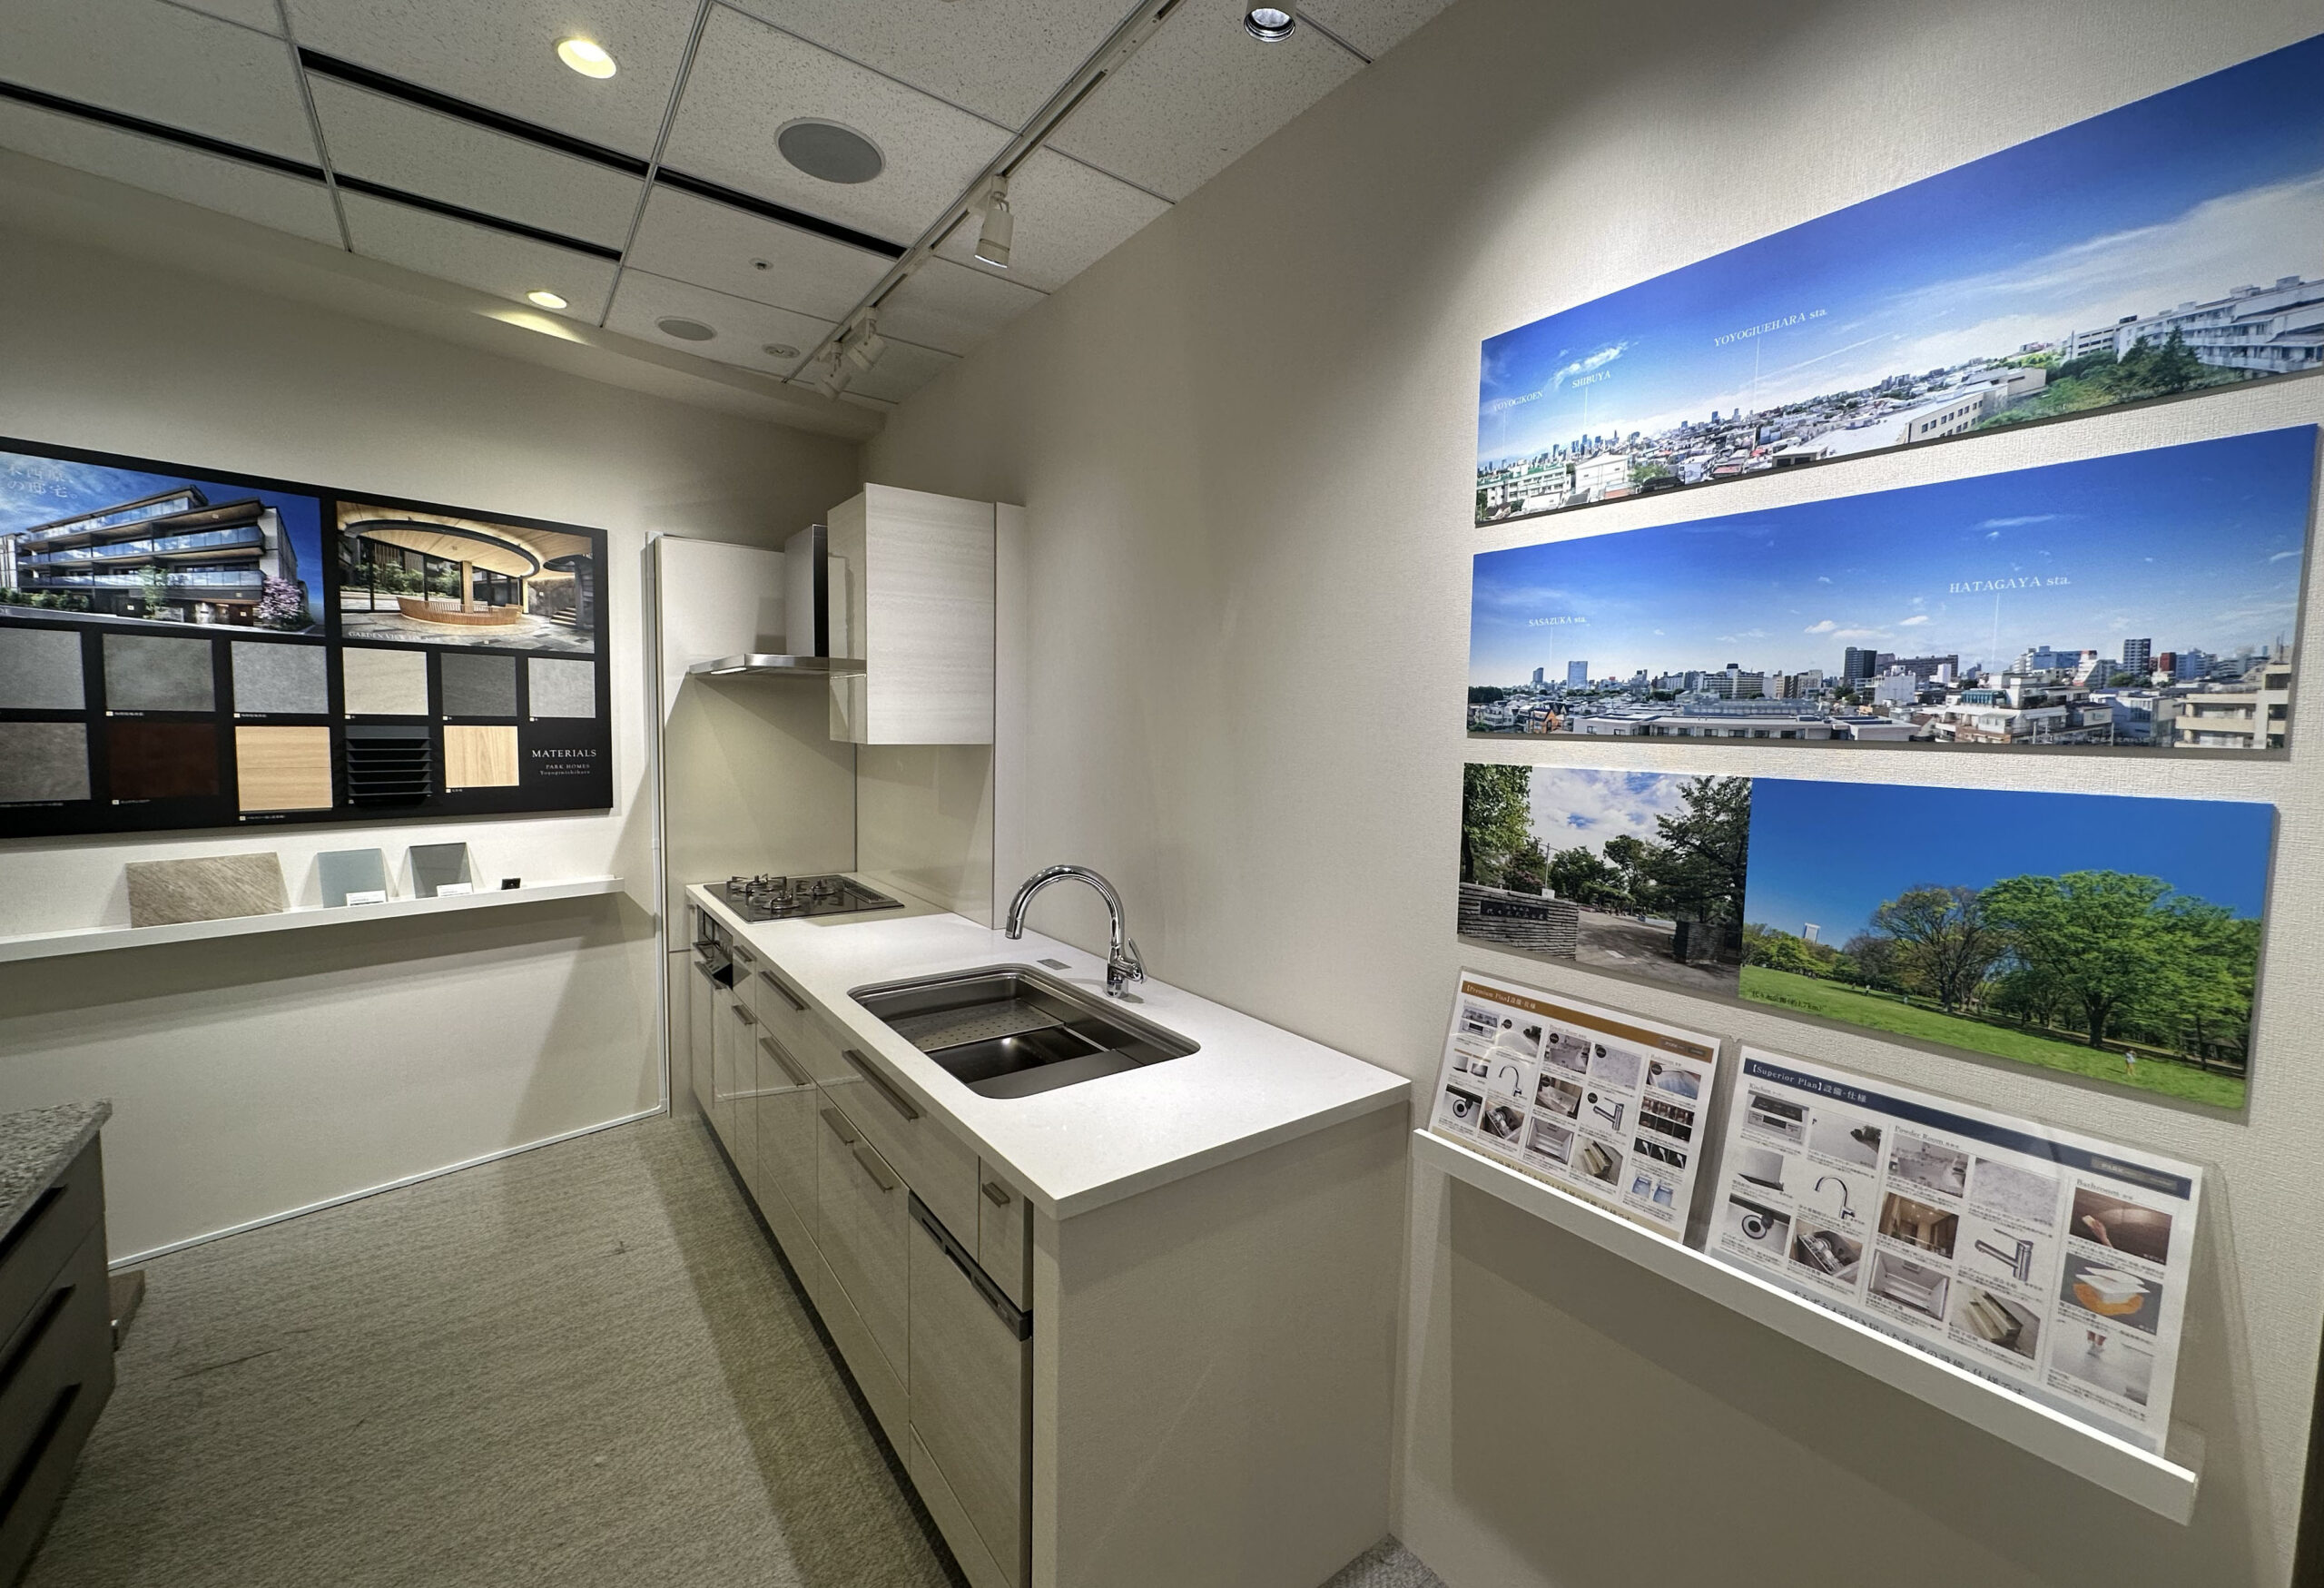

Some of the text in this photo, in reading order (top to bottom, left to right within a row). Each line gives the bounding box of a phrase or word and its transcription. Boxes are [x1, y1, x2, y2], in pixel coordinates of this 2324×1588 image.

[1714, 312, 1806, 347] YOYOGIUEHARA
[1571, 370, 1611, 389] SHIBUYA
[1492, 390, 1543, 411] YOYOGIKOEN
[1949, 576, 2071, 593] HATAGAYA sta.
[1529, 616, 1572, 626] SASAZUKA
[531, 749, 596, 758] MATERIALS
[1753, 1064, 1795, 1083] 【Superior
